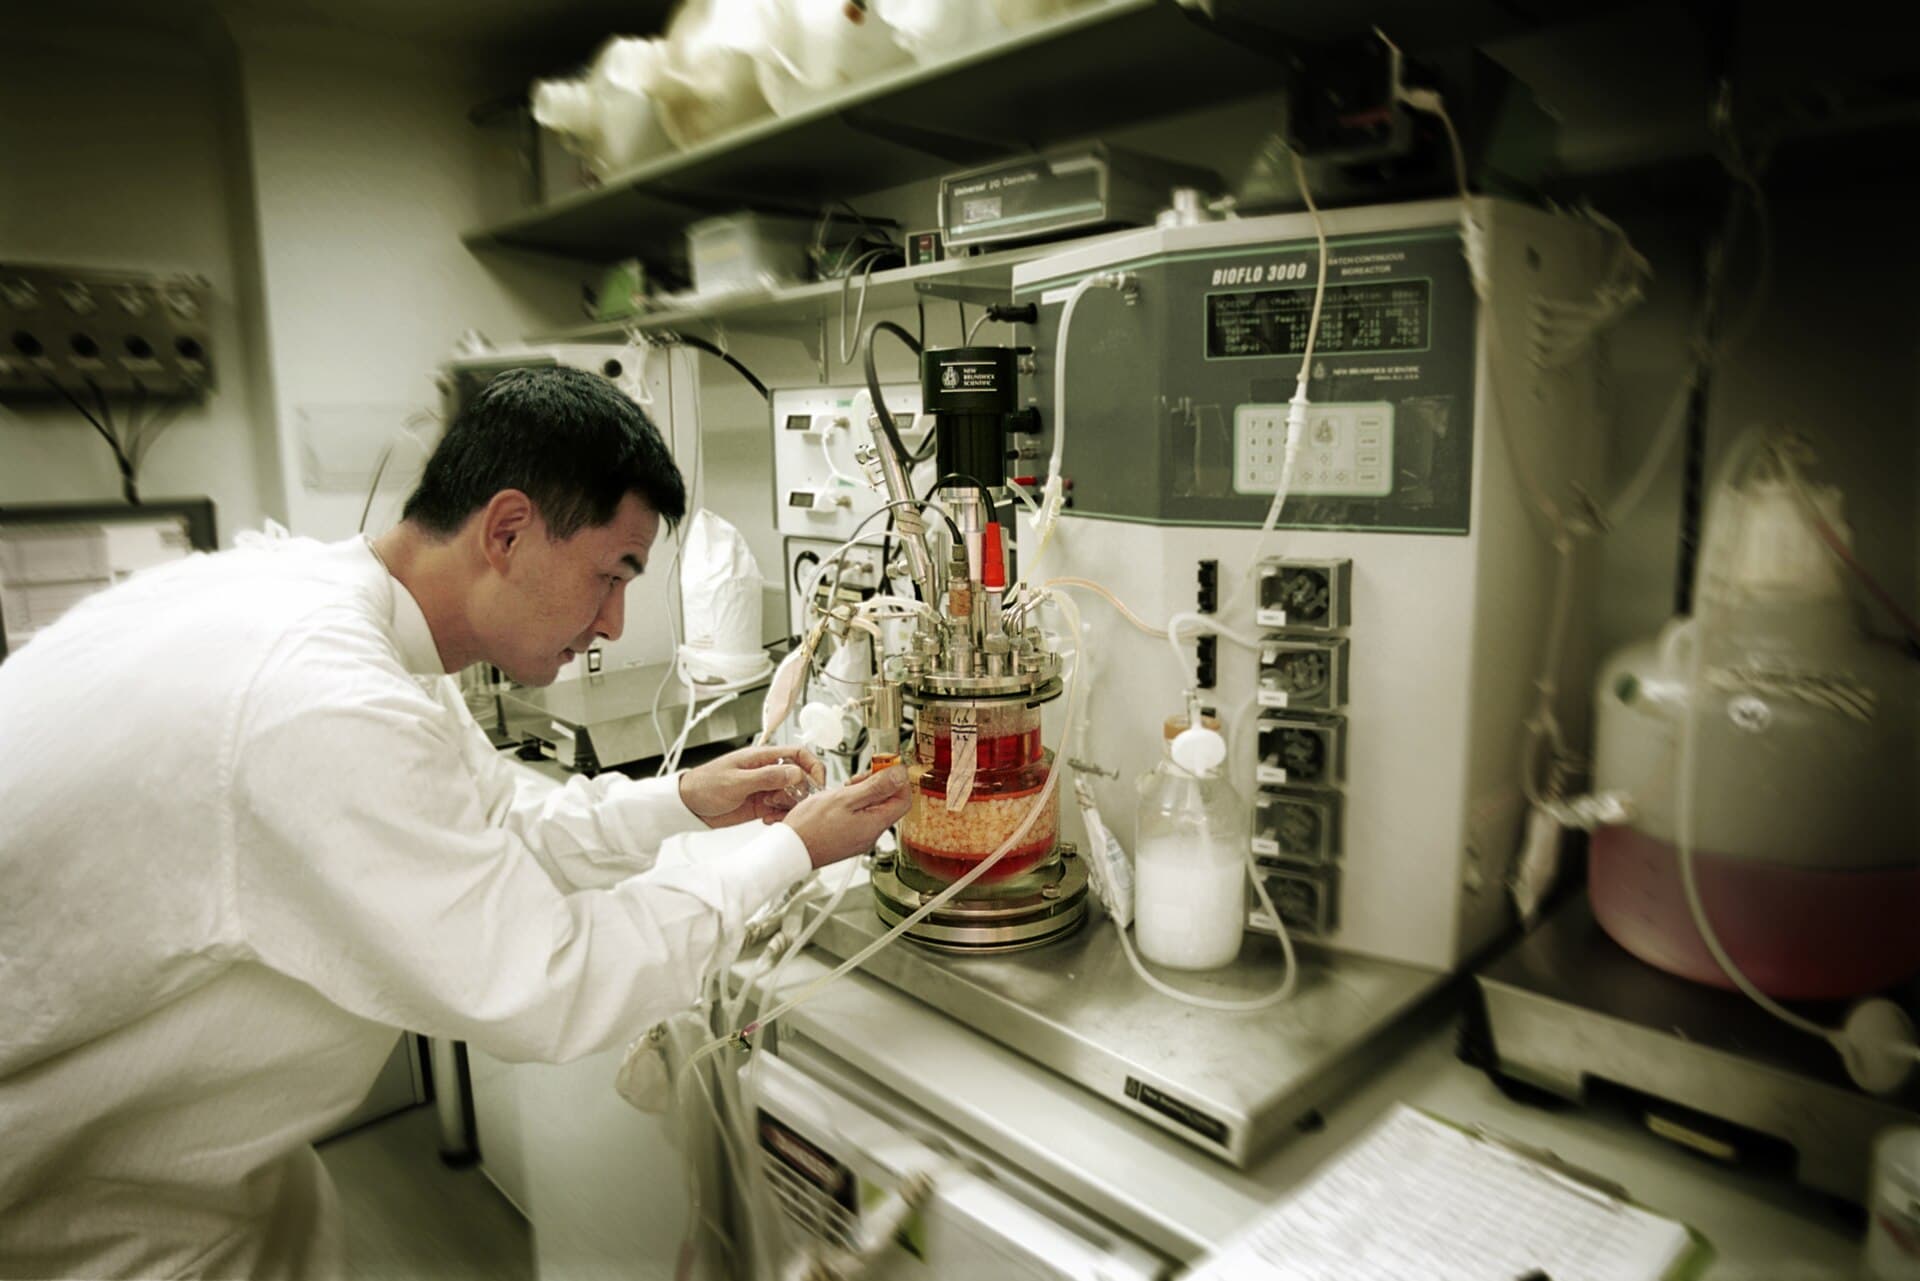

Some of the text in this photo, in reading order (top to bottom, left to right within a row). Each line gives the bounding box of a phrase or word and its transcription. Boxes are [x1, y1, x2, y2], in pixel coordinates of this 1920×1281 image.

[1211, 262, 1307, 286] BIOFLO 3000
[1341, 265, 1391, 276] BIOREACTOR
